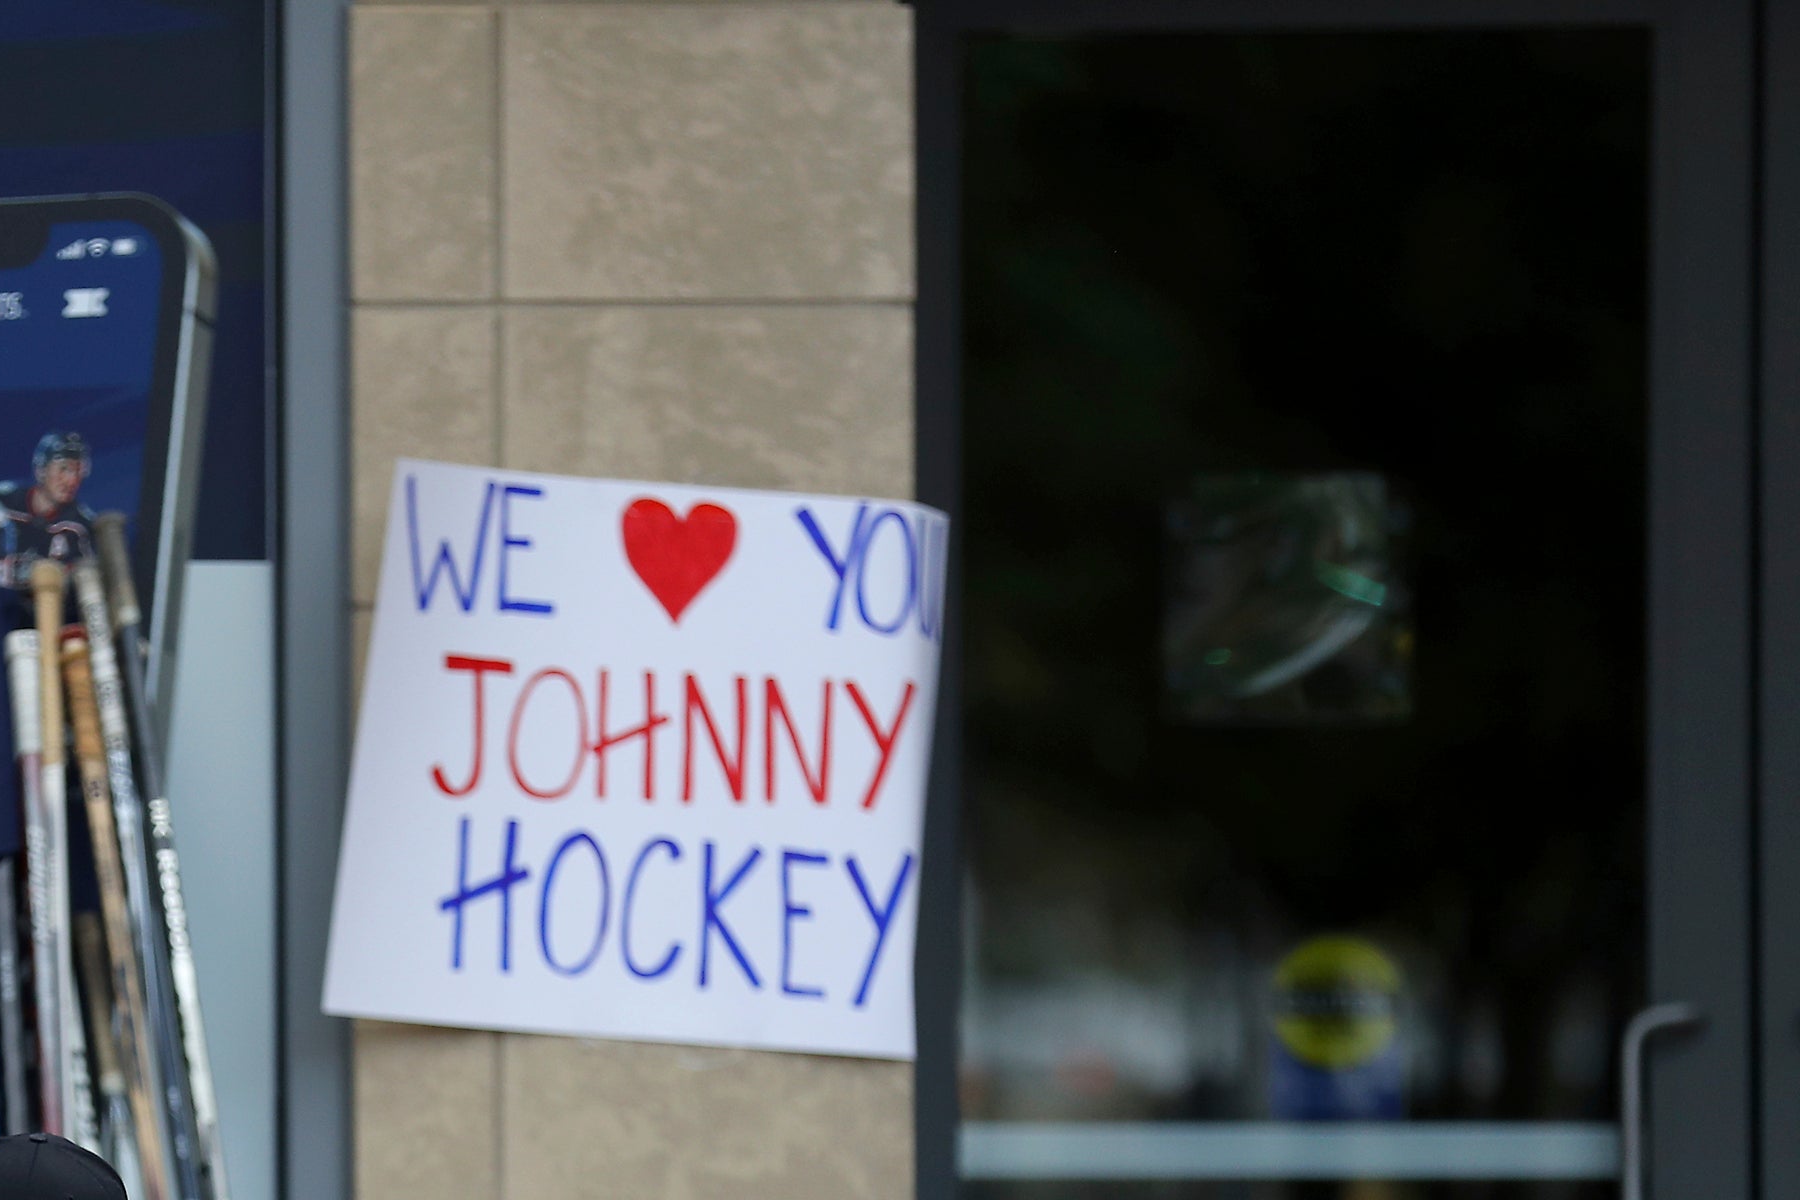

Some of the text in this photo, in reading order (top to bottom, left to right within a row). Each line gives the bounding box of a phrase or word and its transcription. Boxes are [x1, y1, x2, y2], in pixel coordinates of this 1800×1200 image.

[405, 474, 555, 614] WE
[430, 650, 917, 811] JOHNNY
[437, 814, 916, 1008] HOCKEY
